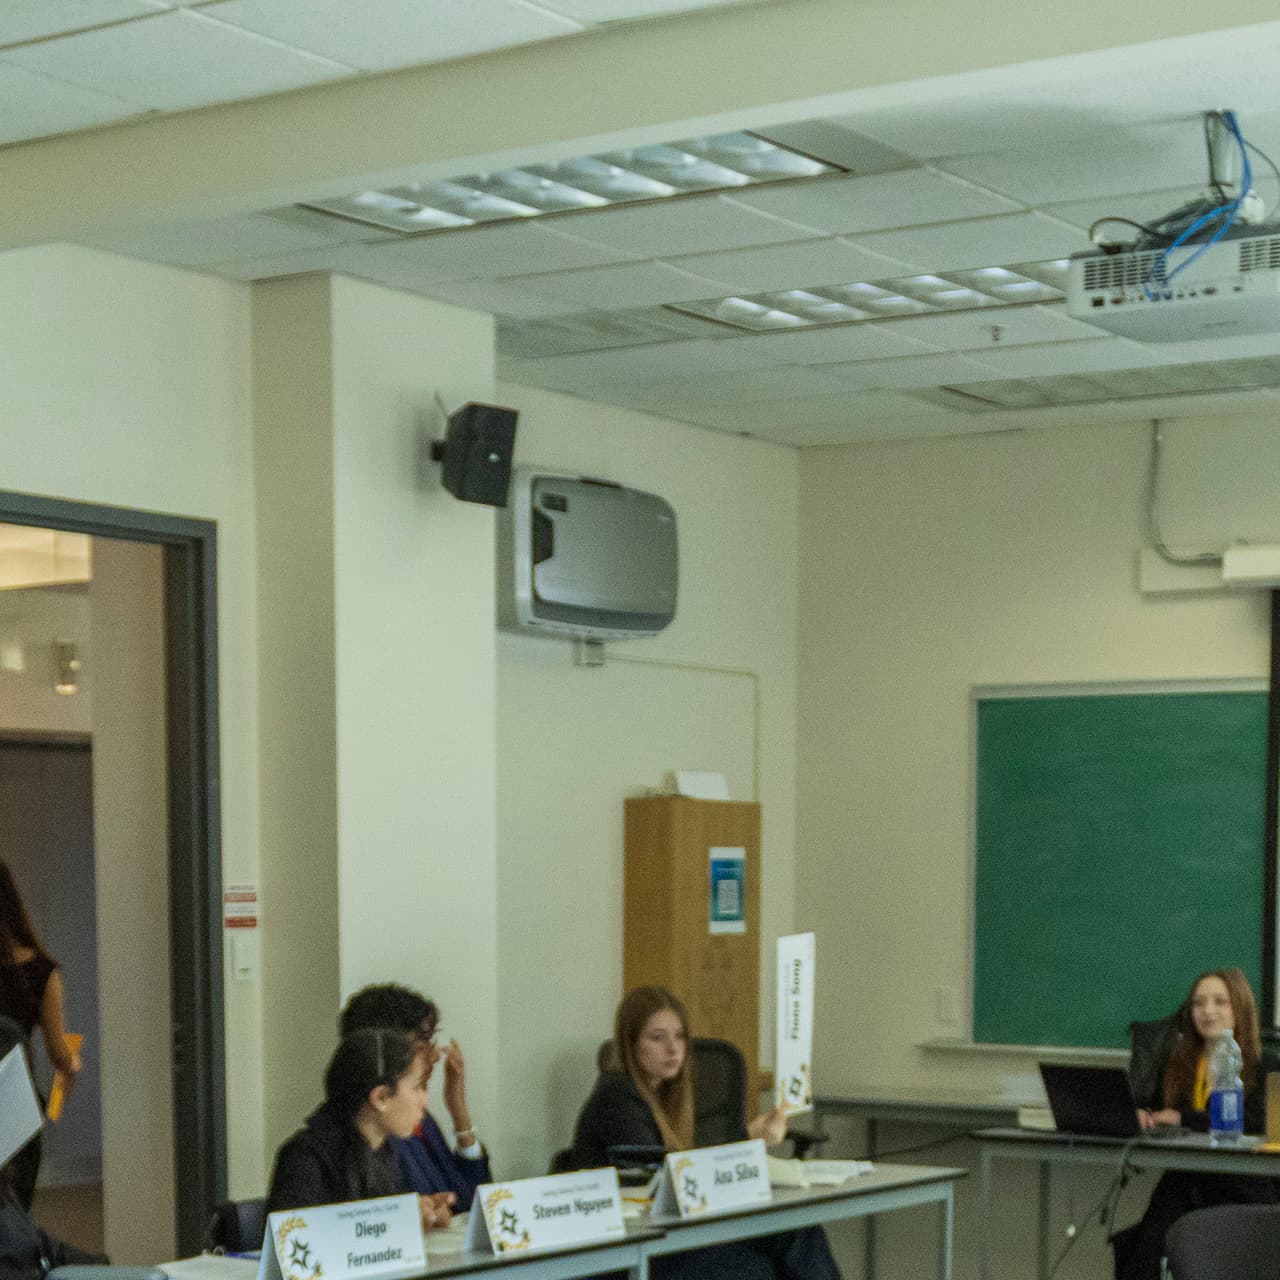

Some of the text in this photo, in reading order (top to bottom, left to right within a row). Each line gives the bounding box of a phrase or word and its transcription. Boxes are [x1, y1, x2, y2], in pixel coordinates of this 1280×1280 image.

[532, 1196, 614, 1221] Steven Nguyen
[354, 1220, 388, 1238] Diego
[346, 1246, 403, 1269] Fernandez
